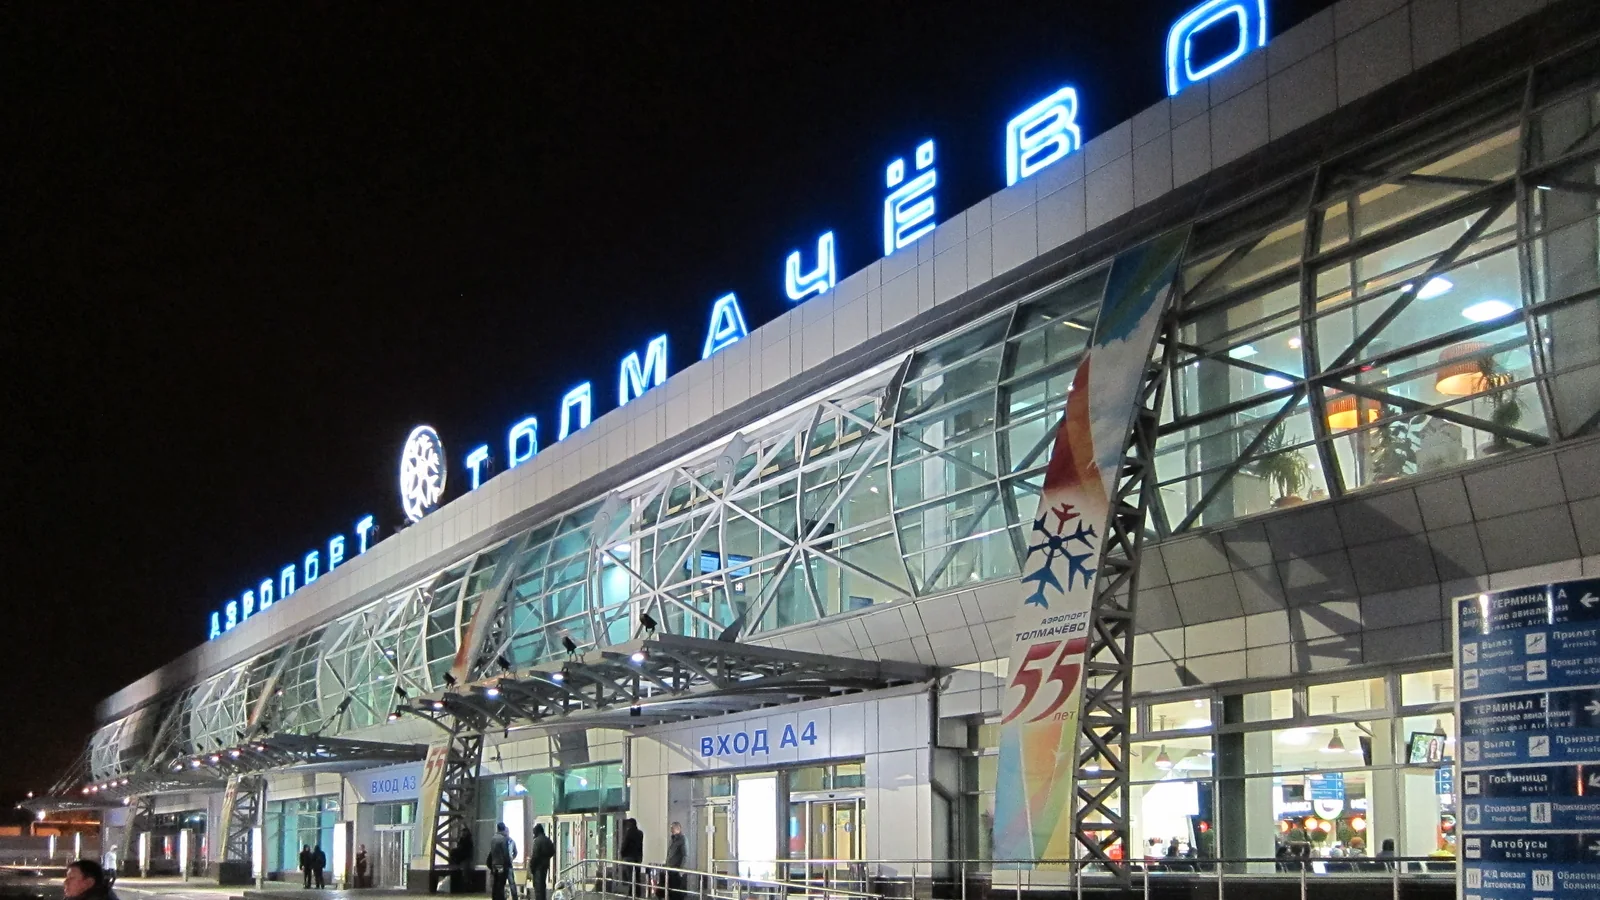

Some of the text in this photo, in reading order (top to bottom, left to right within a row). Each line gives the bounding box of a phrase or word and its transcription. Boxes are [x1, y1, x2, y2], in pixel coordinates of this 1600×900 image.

[209, 0, 1267, 641] АЭРОПОРТ ТОЛМАЧЁВО
[1041, 611, 1089, 626] АЭРОПОРТ
[1015, 621, 1086, 642] ТОЛМАЧЁВО
[1552, 629, 1597, 641] Прилет
[1000, 636, 1089, 726] 55
[1474, 701, 1533, 715] ТЕРМИНАЛ
[1053, 710, 1077, 721] лет
[701, 721, 818, 757] ВХОД А4
[1483, 740, 1516, 749] Вылет
[371, 775, 416, 794] ВХОД А3
[1489, 773, 1548, 784] Гостиница
[1484, 804, 1527, 813] Столовая
[1490, 839, 1548, 851] Автобусы
[1535, 873, 1551, 887] 101
